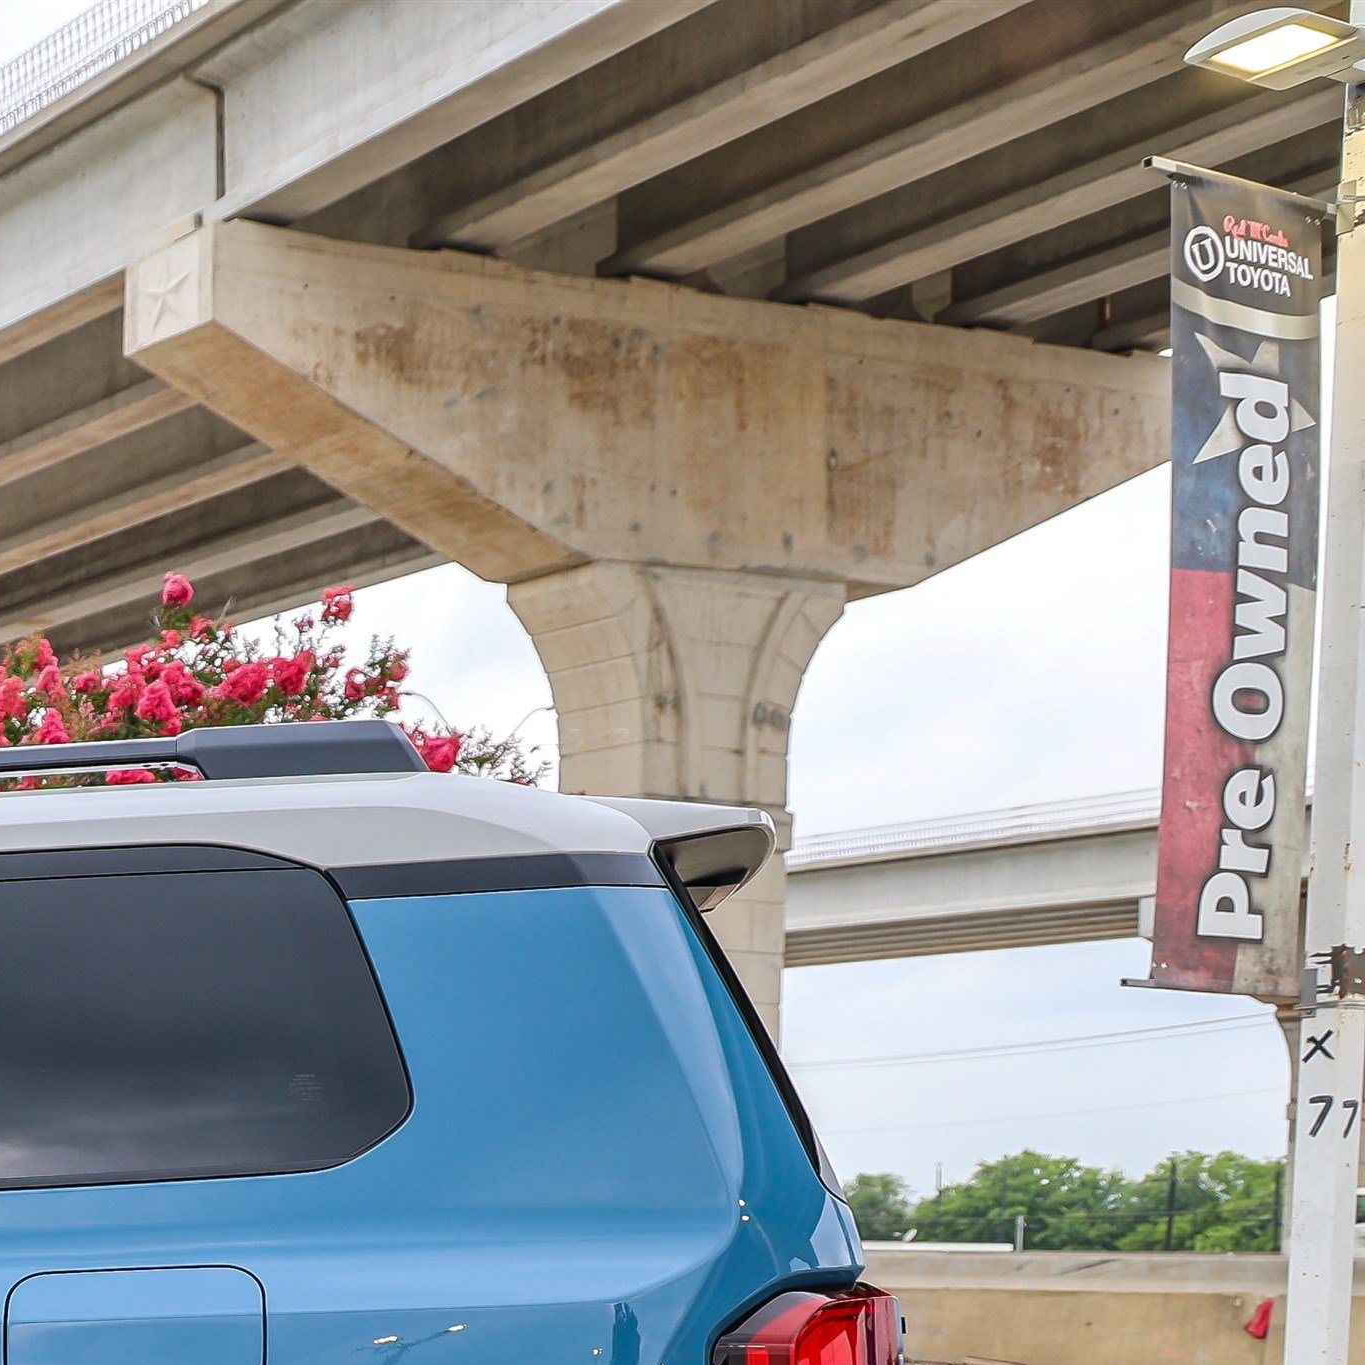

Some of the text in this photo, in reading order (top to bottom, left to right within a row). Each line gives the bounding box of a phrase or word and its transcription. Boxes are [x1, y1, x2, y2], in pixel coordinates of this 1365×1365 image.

[1224, 235, 1315, 280] UNIVERSAL
[1225, 261, 1291, 297] TOYOTA
[1196, 371, 1289, 941] Pre Owned
